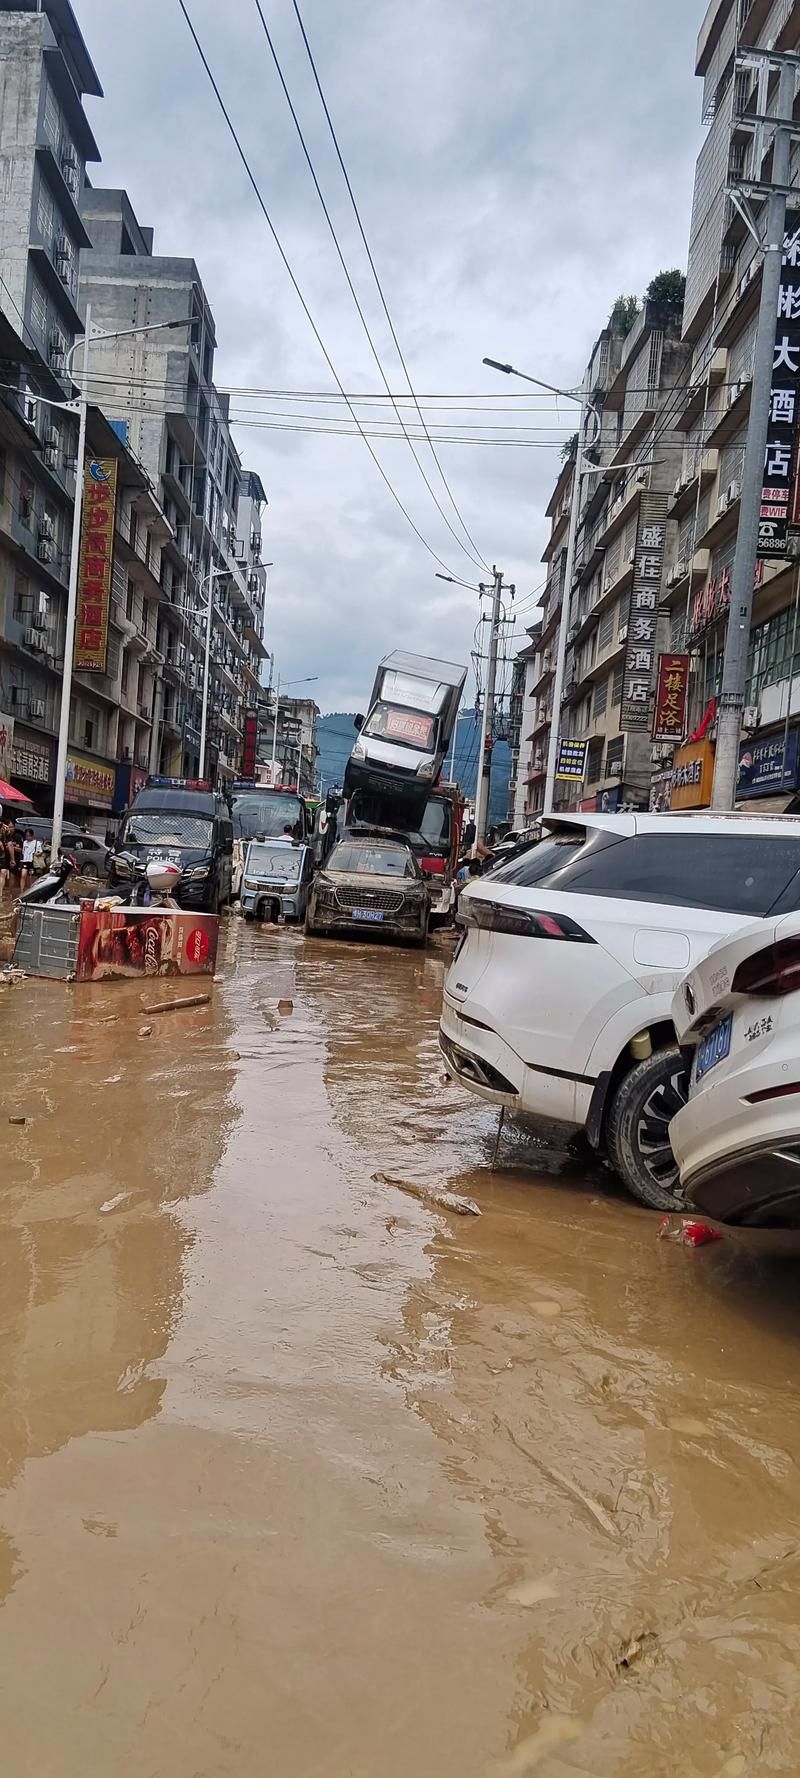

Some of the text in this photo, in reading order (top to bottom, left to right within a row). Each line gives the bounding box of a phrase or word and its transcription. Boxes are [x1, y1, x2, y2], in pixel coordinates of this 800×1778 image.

[627, 525, 664, 702] 盛佳商务酒店
[659, 659, 685, 727] 二楼足浴
[146, 855, 181, 863] POLICE
